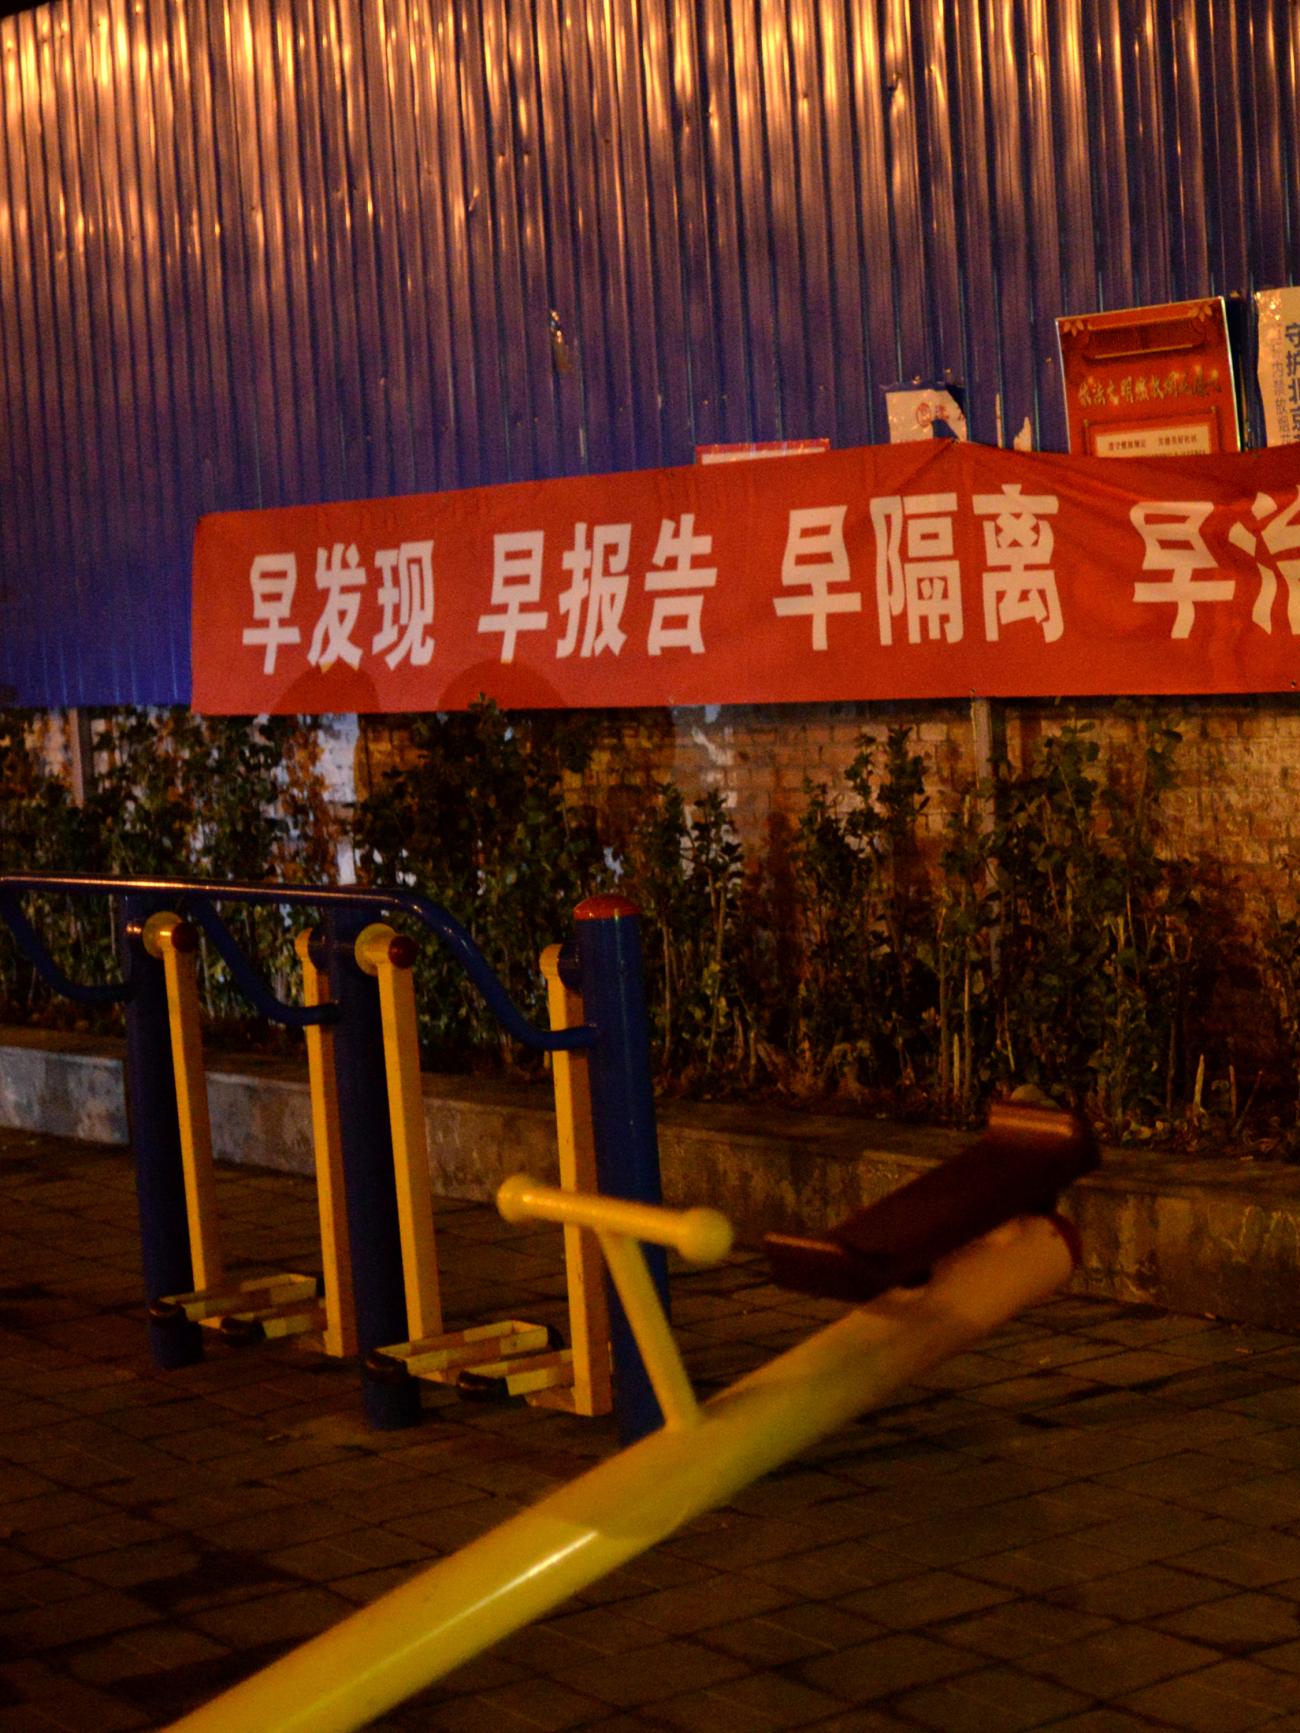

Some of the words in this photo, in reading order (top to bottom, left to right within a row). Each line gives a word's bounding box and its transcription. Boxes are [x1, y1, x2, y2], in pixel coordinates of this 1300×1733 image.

[241, 540, 436, 675] 早发现
[476, 513, 718, 664] 早报告
[772, 483, 1066, 652] 早隔离
